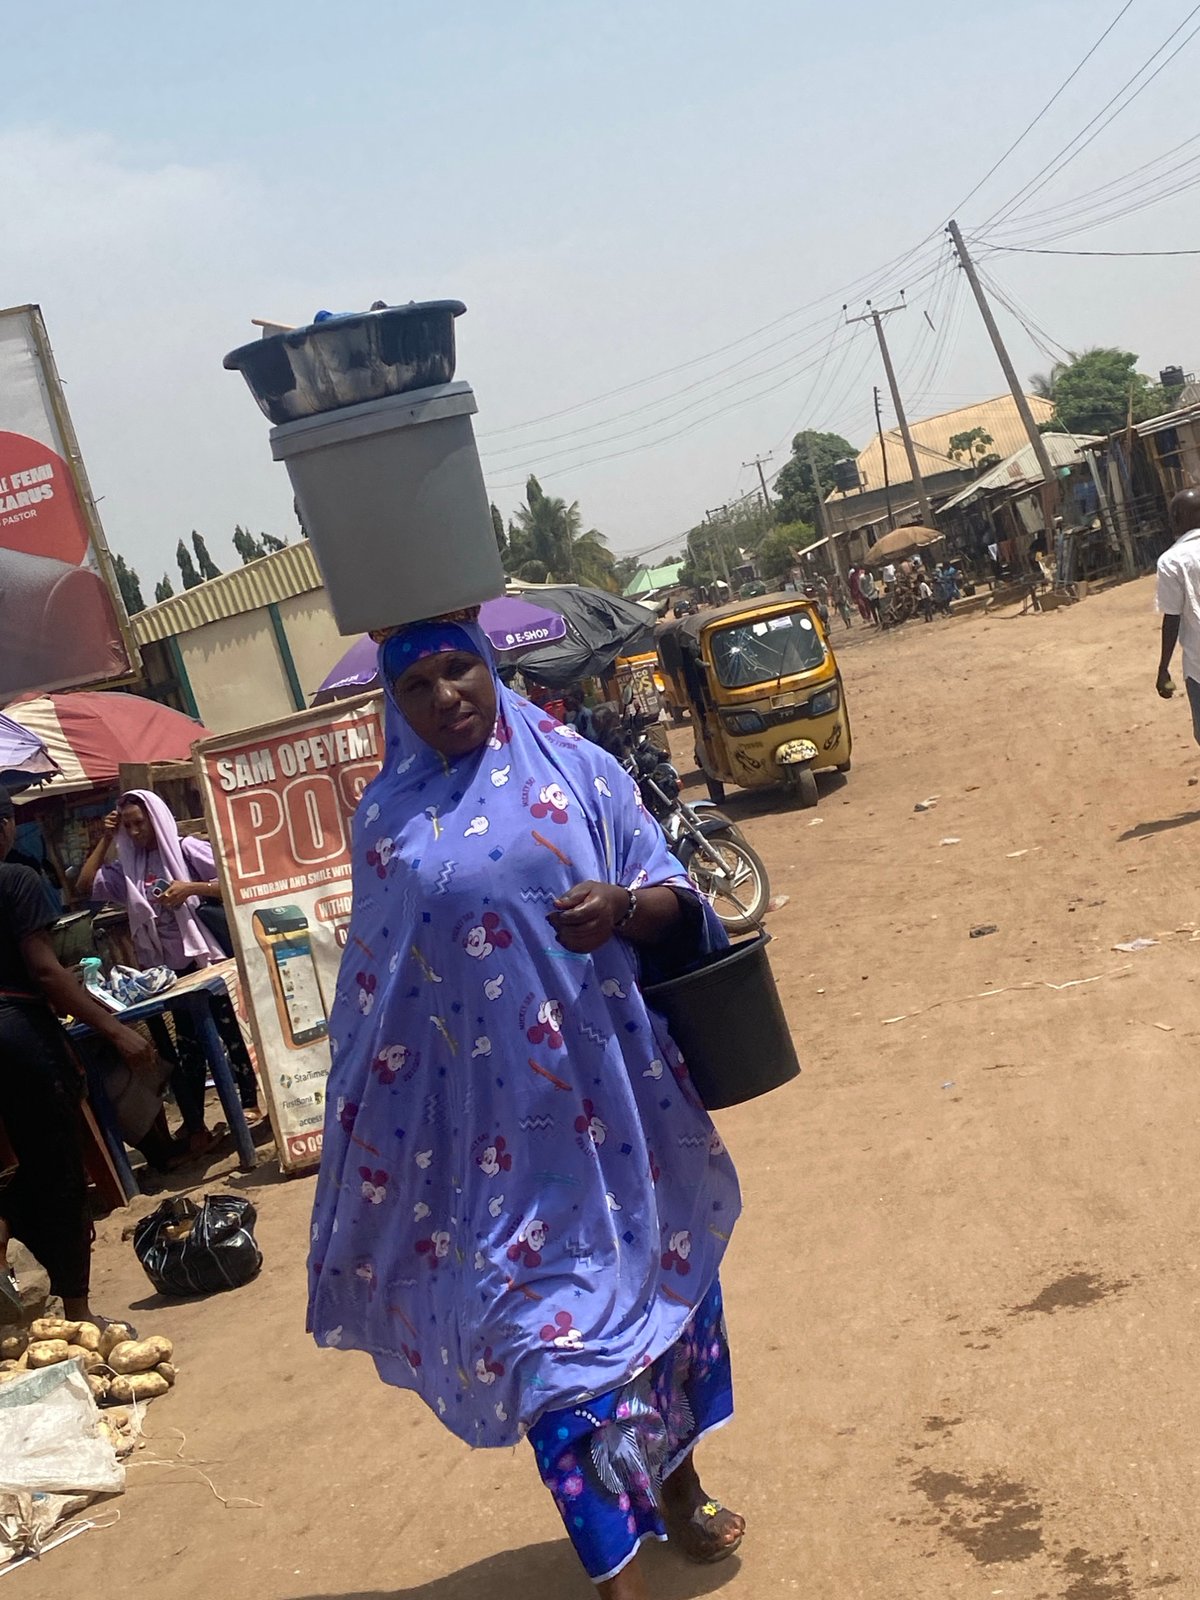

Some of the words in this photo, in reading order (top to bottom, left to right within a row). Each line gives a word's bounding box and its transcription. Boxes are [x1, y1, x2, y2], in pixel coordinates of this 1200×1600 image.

[10, 463, 53, 489] FEMI
[2, 509, 37, 526] PASTOR
[514, 628, 549, 643] E-SHOP
[217, 748, 276, 791] SAM
[277, 723, 378, 777] OPEYEMI
[240, 879, 289, 899] WITHDRAW
[289, 874, 308, 889] AND
[308, 868, 332, 884] SMILE
[318, 895, 353, 919] WITHD
[293, 1068, 329, 1083] StarTimes
[299, 1114, 323, 1127] access
